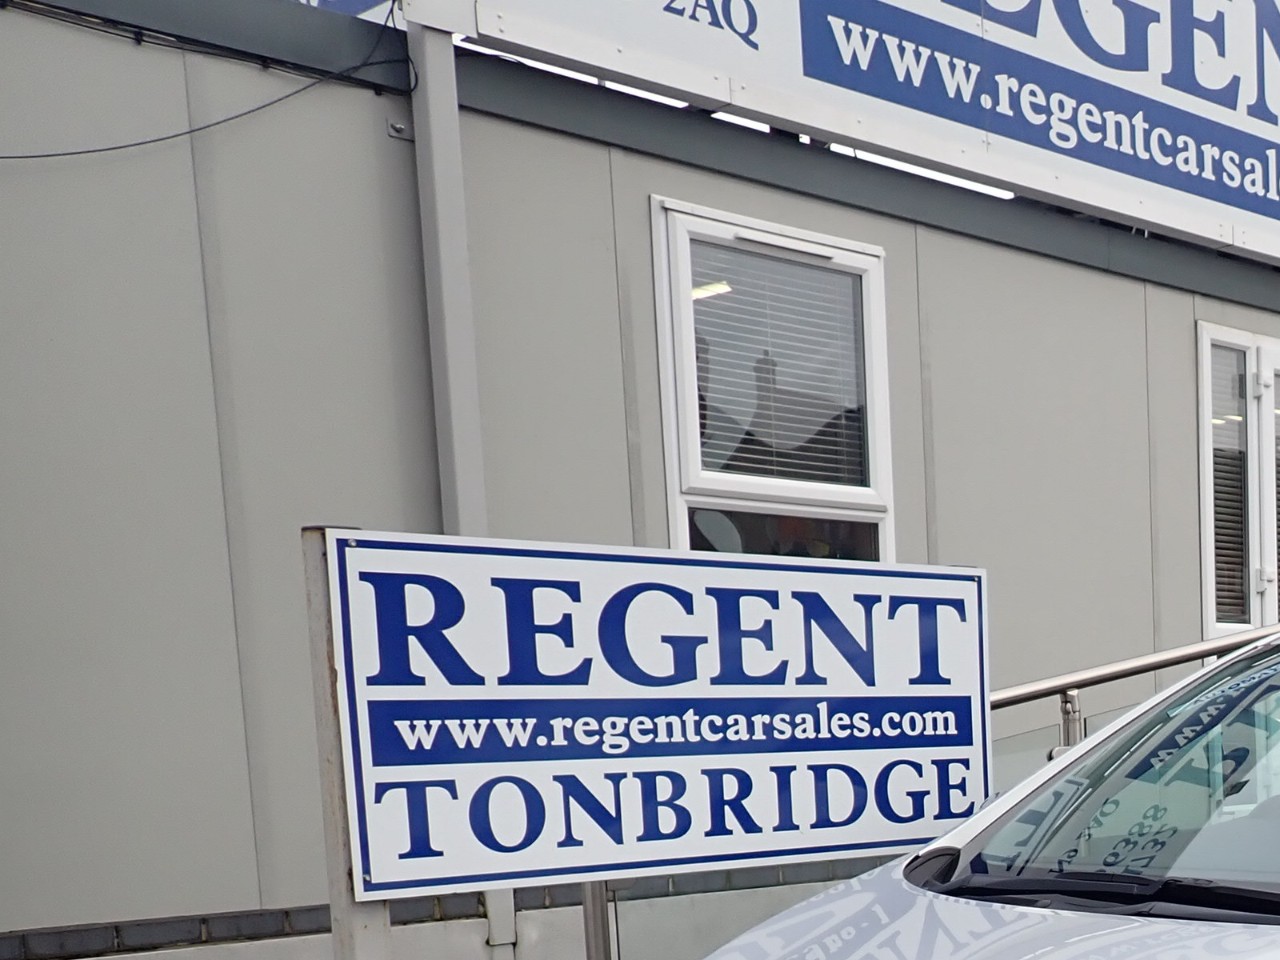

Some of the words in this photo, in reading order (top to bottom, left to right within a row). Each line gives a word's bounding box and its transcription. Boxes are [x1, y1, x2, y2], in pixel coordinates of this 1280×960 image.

[358, 571, 967, 687] REGENT
[394, 701, 958, 754] www.regentcarsales.com
[374, 758, 975, 860] TONBRIDGE
